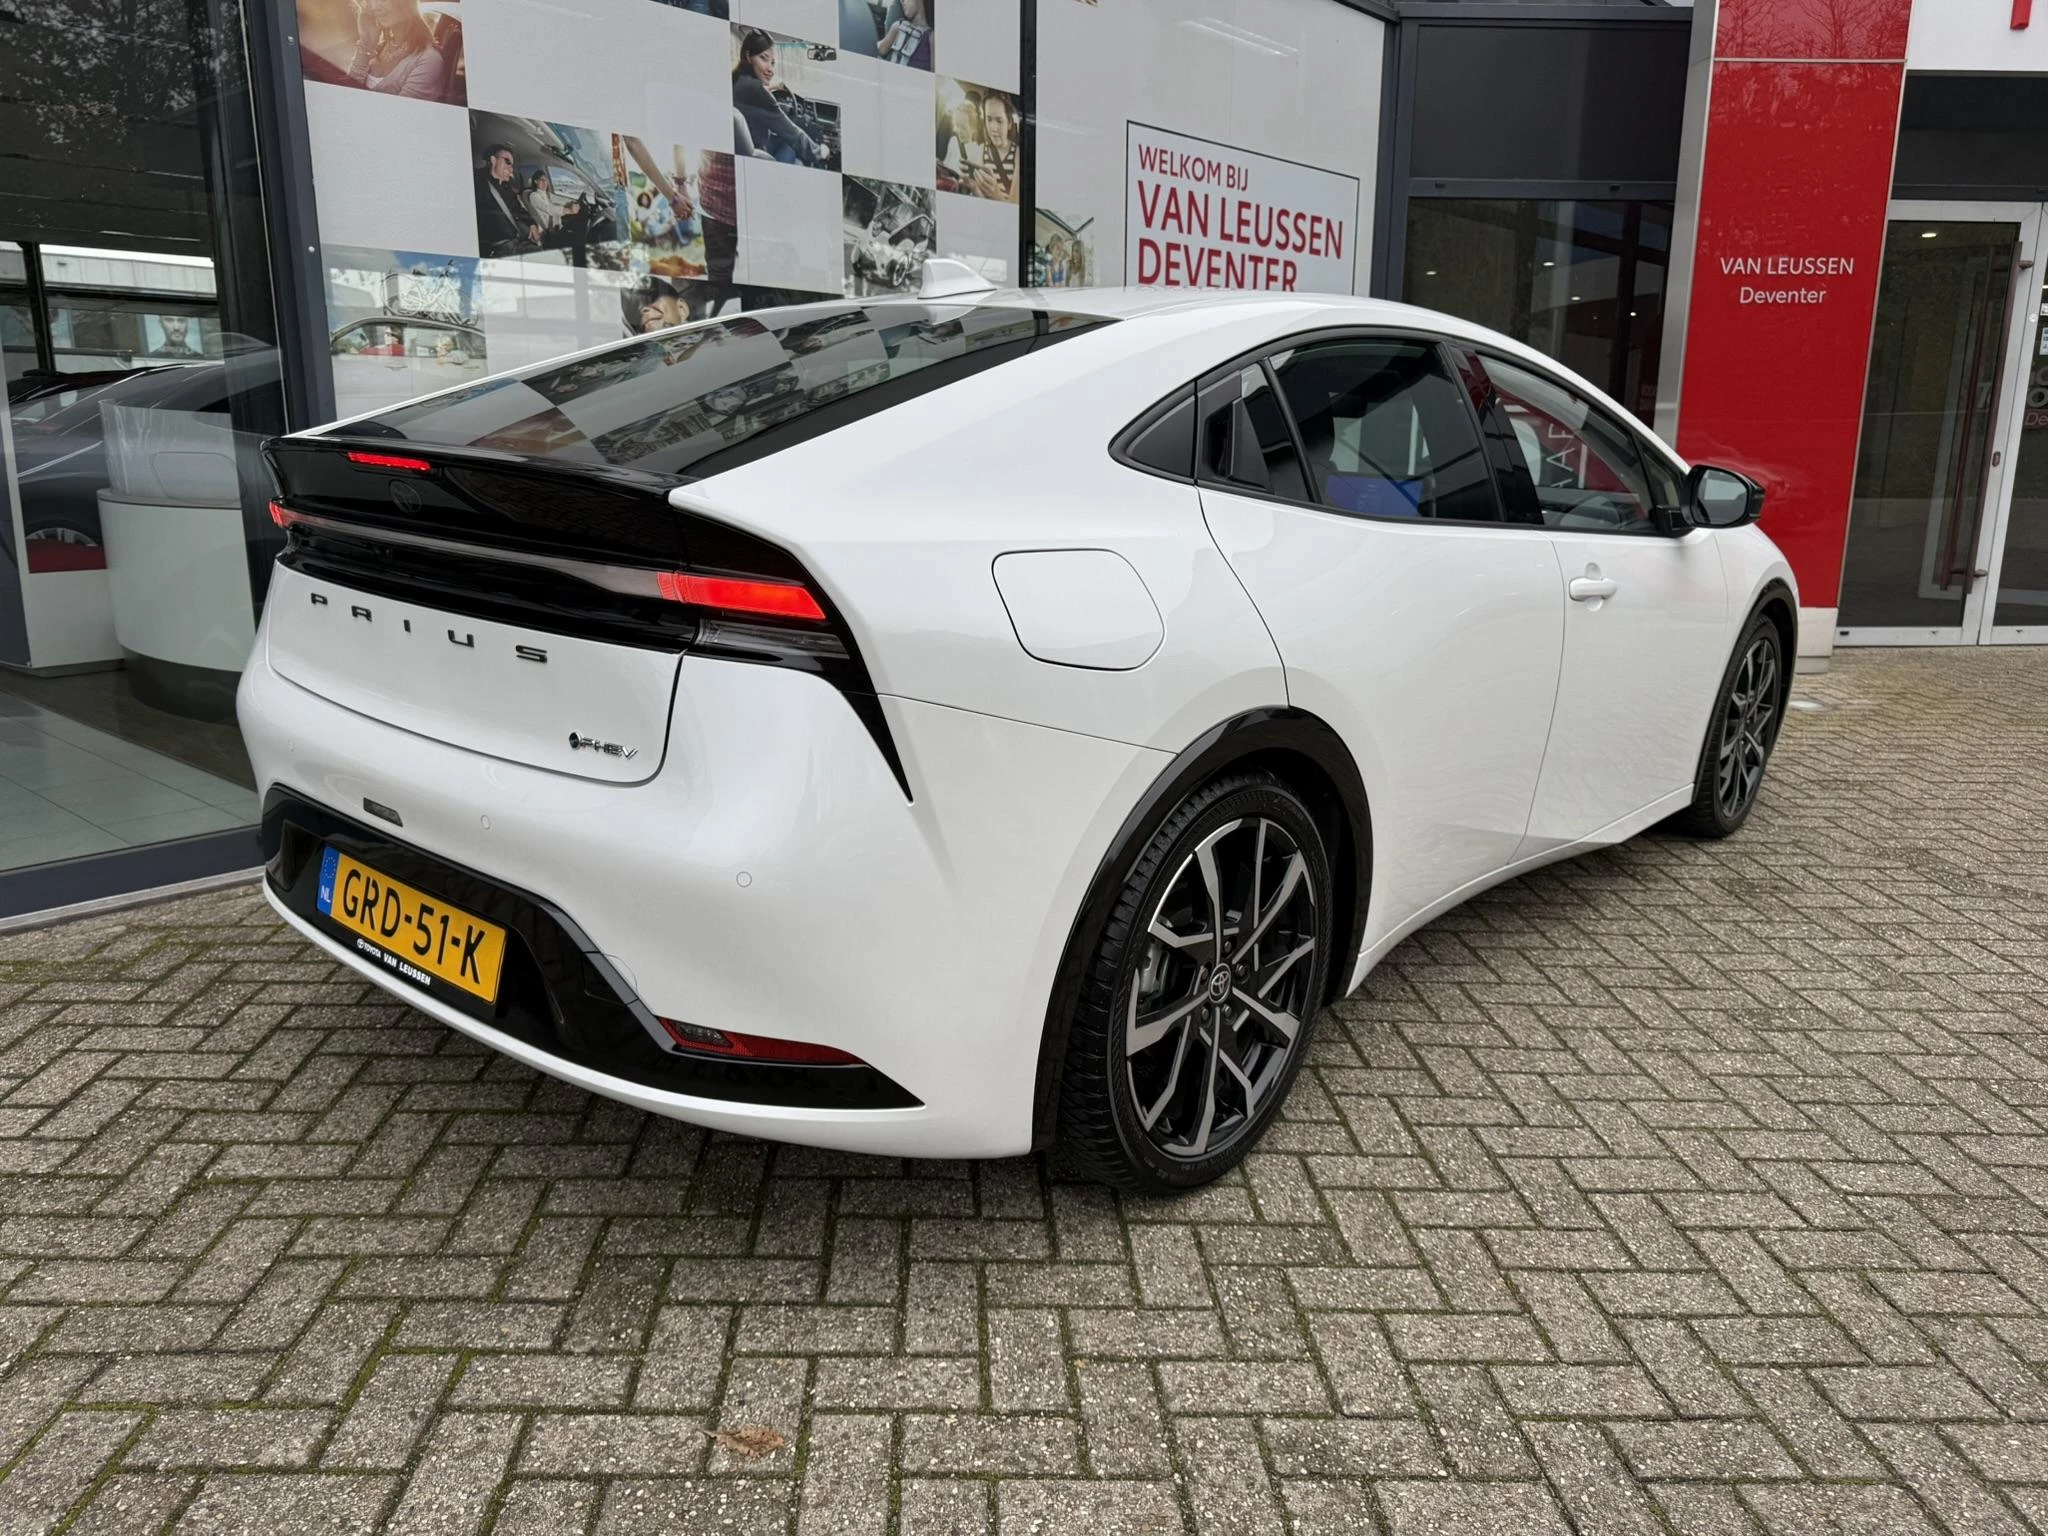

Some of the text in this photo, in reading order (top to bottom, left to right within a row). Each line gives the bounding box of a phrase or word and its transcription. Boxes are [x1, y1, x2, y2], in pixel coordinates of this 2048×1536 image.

[1138, 143, 1249, 192] WELKOM BIJ
[1137, 180, 1343, 260] VAN LEUSSEN
[1137, 237, 1298, 293] DEVENTER
[1720, 256, 1855, 275] VAN LEUSSEN
[1739, 286, 1828, 304] Deventer
[310, 592, 548, 664] PRIUS
[580, 736, 639, 760] PHEV
[320, 884, 332, 904] NL
[343, 868, 486, 985] GRD-51-K
[364, 942, 431, 986] TOYOTA VAN LEUSSEN
